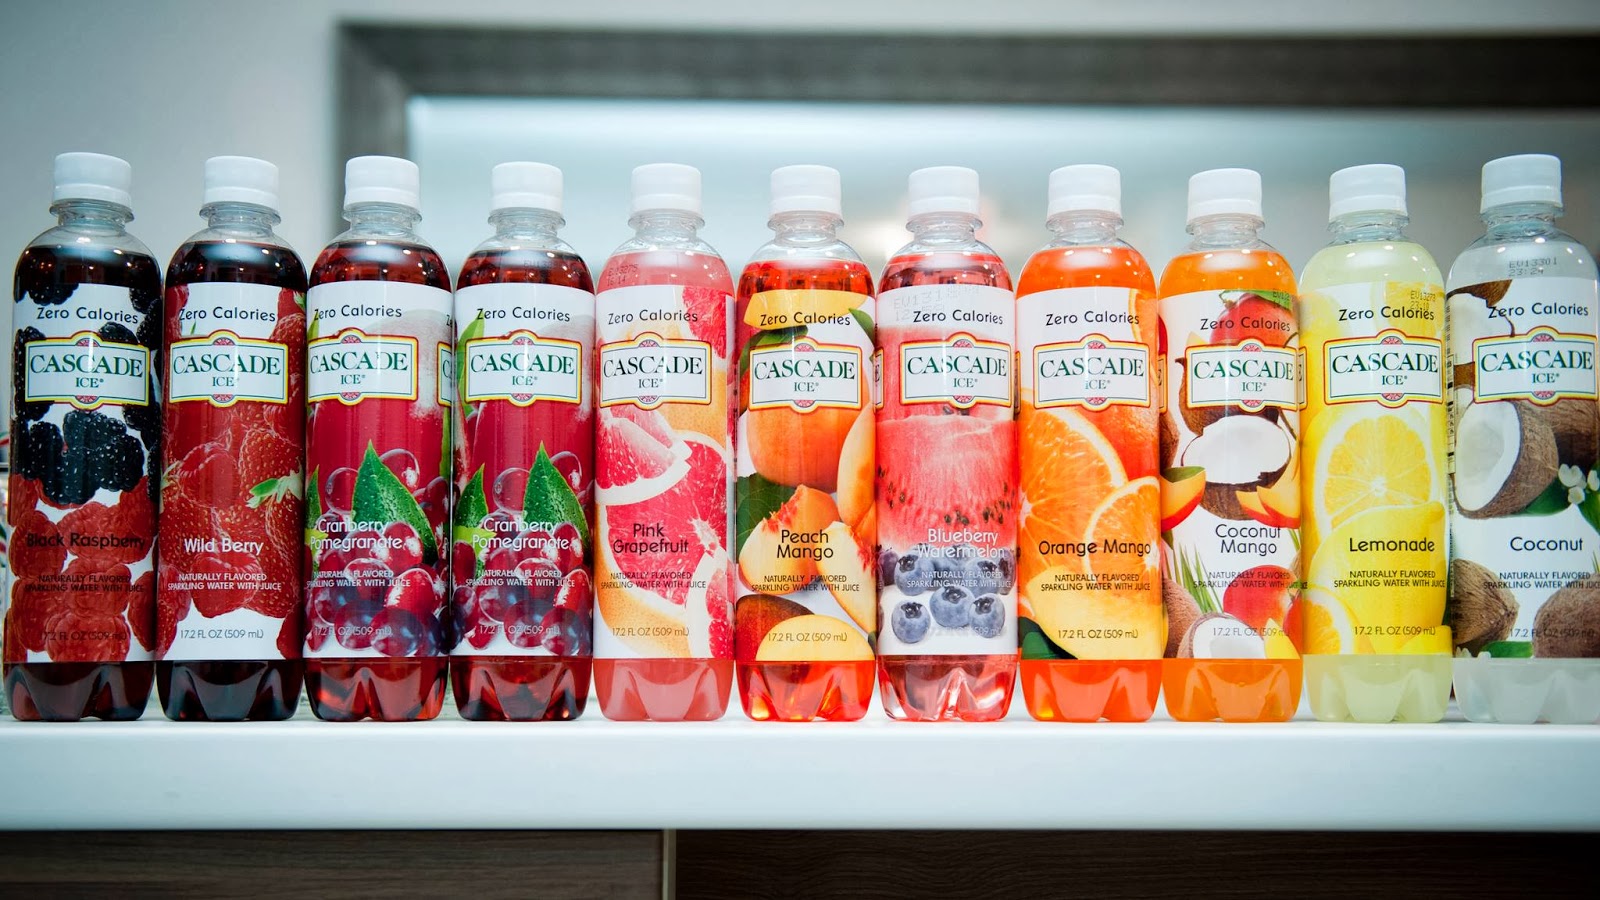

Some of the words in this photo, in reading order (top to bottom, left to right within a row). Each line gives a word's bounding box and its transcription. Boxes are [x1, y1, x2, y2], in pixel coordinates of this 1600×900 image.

[37, 307, 69, 321] Zero
[76, 307, 139, 324] Calories
[178, 307, 208, 321] Zero
[213, 306, 276, 322] Calories
[314, 308, 337, 321] Zero
[340, 304, 402, 318] Calories
[476, 308, 507, 321] Zero
[512, 306, 571, 322] Calories
[608, 312, 634, 326] Zero
[638, 309, 699, 322] Calories
[913, 310, 946, 323] Zero
[952, 309, 1004, 325] Calories
[1046, 313, 1078, 326] Zero
[1084, 310, 1140, 325] Calories
[1338, 308, 1374, 321] Zero
[1380, 306, 1435, 321] Calories
[1488, 305, 1525, 319] Zero
[1531, 302, 1589, 316] Calories
[759, 313, 788, 327] Zero
[793, 311, 851, 326] Calories
[1200, 318, 1234, 331] Zero
[1241, 316, 1291, 331] Calories
[30, 354, 143, 377] CASCADE
[173, 354, 281, 376] CASCADE
[310, 351, 408, 373] CASCADE
[470, 353, 575, 374] CASCADE
[603, 356, 703, 378] CASCADE
[907, 354, 1007, 376] CASCADE
[1040, 357, 1144, 379] CASCADE
[1332, 352, 1439, 375] CASCADE
[1480, 350, 1593, 372] CASCADE
[754, 359, 856, 380] CASCADE
[1194, 359, 1294, 381] CASCADE
[318, 518, 388, 536] Cranberry
[483, 517, 555, 536] Cranberry
[633, 523, 665, 537] Pink
[1215, 523, 1281, 538] Coconut
[70, 532, 145, 551] Raspberry
[310, 535, 403, 553] Pomegranate
[471, 534, 570, 551] Pomegranate
[781, 529, 829, 544] Peach
[928, 528, 998, 545] Blueberry
[1349, 537, 1435, 552] Lemonade
[1509, 536, 1583, 551] Coconut
[184, 537, 215, 553] Wild
[222, 538, 264, 556] Berry
[613, 538, 689, 555] Grapefruit
[776, 544, 834, 561] Mango
[917, 544, 1005, 558] Watermelon
[1039, 540, 1098, 557] Orange
[1103, 539, 1151, 557] Mango
[1220, 539, 1277, 556] Mango
[179, 573, 221, 581] NATURALLY
[224, 573, 267, 581] FLAVORED
[611, 572, 649, 580] NATURALLY
[651, 571, 692, 579] FLAVORED
[764, 575, 805, 583] NATURALLY
[921, 571, 965, 579] NATURALLY
[1055, 574, 1100, 582] NATURALLY
[1349, 570, 1397, 578] NATURALLY
[1400, 570, 1436, 578] FLAVORED
[1499, 572, 1549, 580] NATURALLY
[168, 582, 204, 591] SPARKLING
[207, 582, 234, 590] WATER
[237, 582, 258, 590] WITH
[260, 582, 282, 591] JUICE
[336, 579, 361, 587] WATER
[364, 579, 386, 587] WITH
[506, 578, 533, 587] WATER
[535, 578, 555, 586] WITH
[601, 581, 633, 589] SPARKLING
[635, 580, 660, 589] WATER
[662, 580, 683, 588] WITH
[686, 580, 707, 589] JUICE
[752, 583, 790, 592] SPARKLING
[793, 583, 818, 592] WATER
[820, 583, 840, 591] WITH
[842, 583, 860, 592] JUICE
[907, 579, 950, 588] SPARKLING
[952, 579, 978, 587] WATER
[980, 579, 997, 587] WITH
[1041, 582, 1083, 591] SPARKLING
[1086, 582, 1112, 591] WATER
[1114, 582, 1133, 591] WITH
[1134, 583, 1151, 591] JUICE
[1193, 580, 1238, 588] SPARKLING
[1241, 580, 1267, 588] WATER
[1269, 580, 1285, 588] WITH
[1334, 579, 1380, 588] SPARKLING
[1383, 579, 1410, 587] WATER
[1412, 579, 1430, 587] WITH
[1431, 580, 1446, 588] JUICE
[1483, 580, 1532, 589] SPARKLING
[1534, 580, 1562, 589] WATER
[1565, 580, 1583, 588] WITH
[198, 630, 206, 639] FL
[208, 630, 222, 639] OZ
[627, 628, 636, 636] FL
[637, 628, 650, 636] OZ
[785, 633, 794, 641] FL
[796, 633, 810, 641] OZ
[1076, 629, 1086, 638] FL
[1088, 629, 1102, 639] OZ
[1375, 626, 1384, 635] FL
[1386, 626, 1401, 635] OZ
